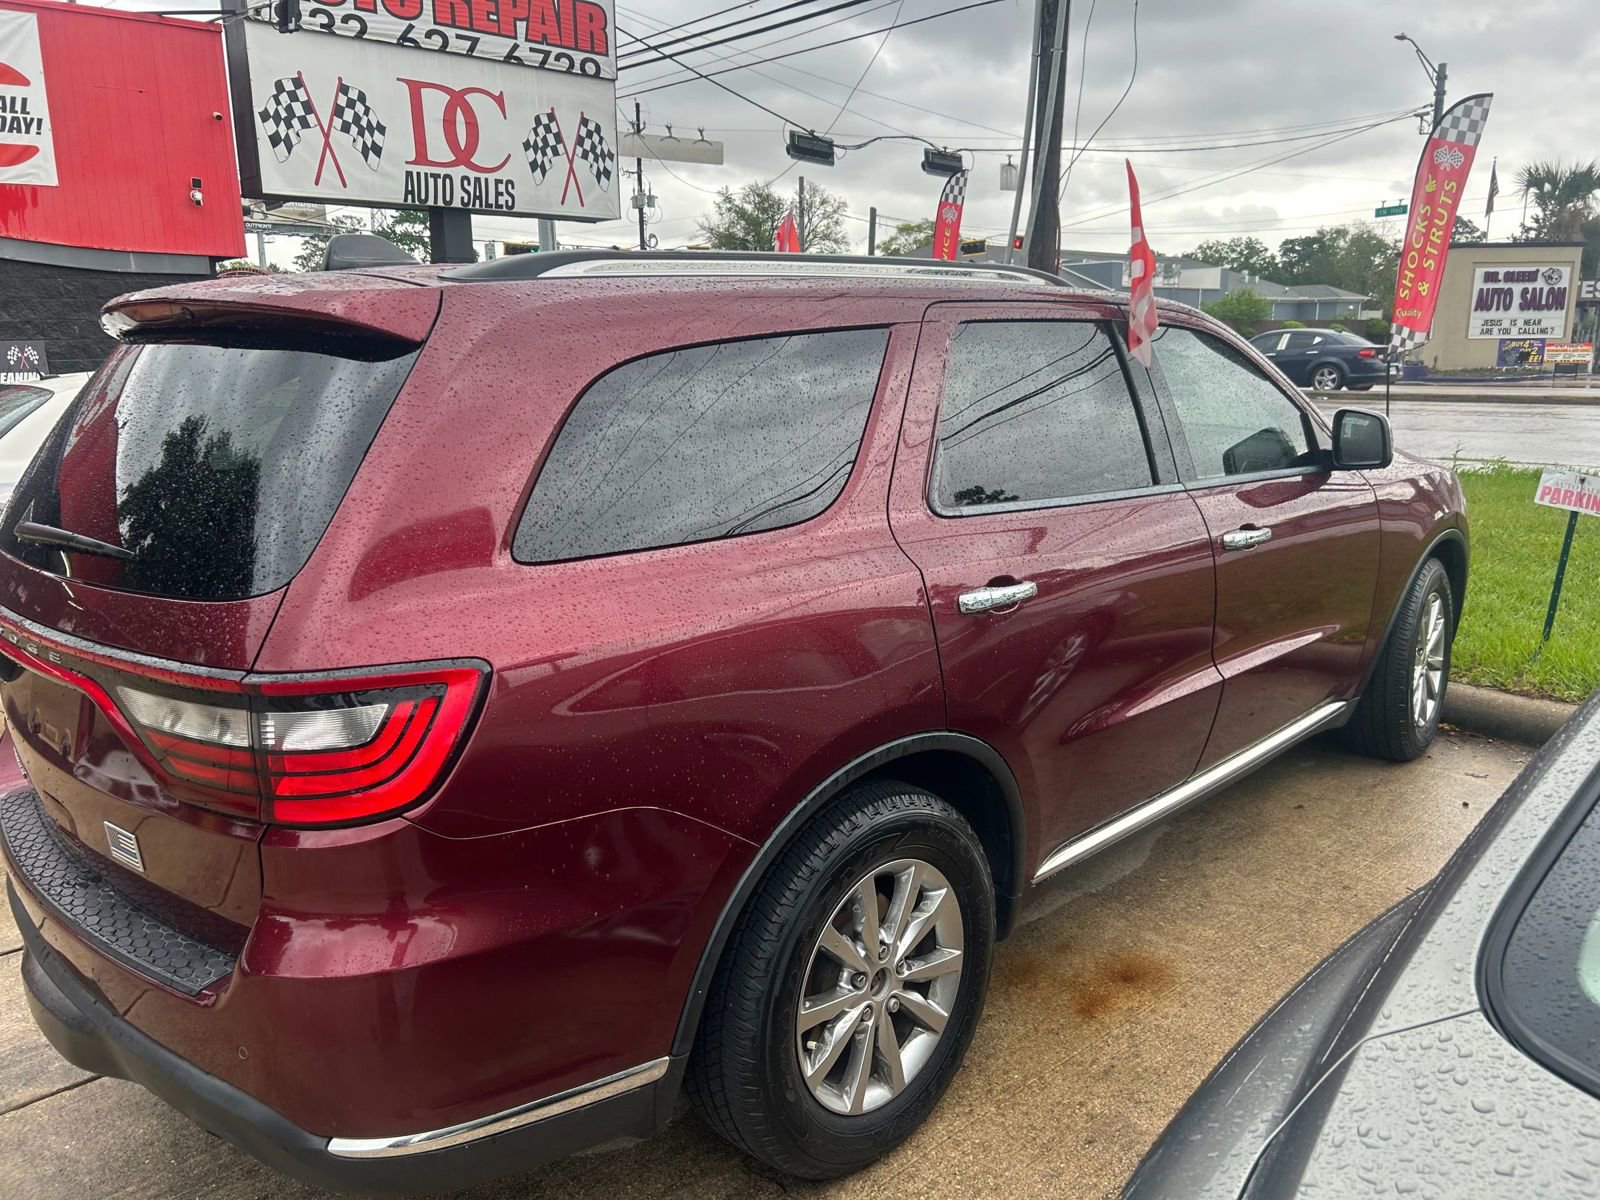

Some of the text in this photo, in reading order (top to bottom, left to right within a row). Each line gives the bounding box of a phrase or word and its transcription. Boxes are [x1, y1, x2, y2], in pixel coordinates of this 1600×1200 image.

[433, 0, 608, 57] REPAIR
[396, 77, 511, 174] DC
[403, 170, 516, 210] AUTO SALES
[1399, 202, 1431, 301] SHOCKS
[1417, 179, 1457, 297] & STRUTS
[1396, 307, 1424, 320] Quality
[1473, 286, 1567, 312] AUTO SALON
[1480, 327, 1494, 336] ARE
[1498, 327, 1511, 335] YOU
[1481, 319, 1542, 327] JESUS IS NEAR
